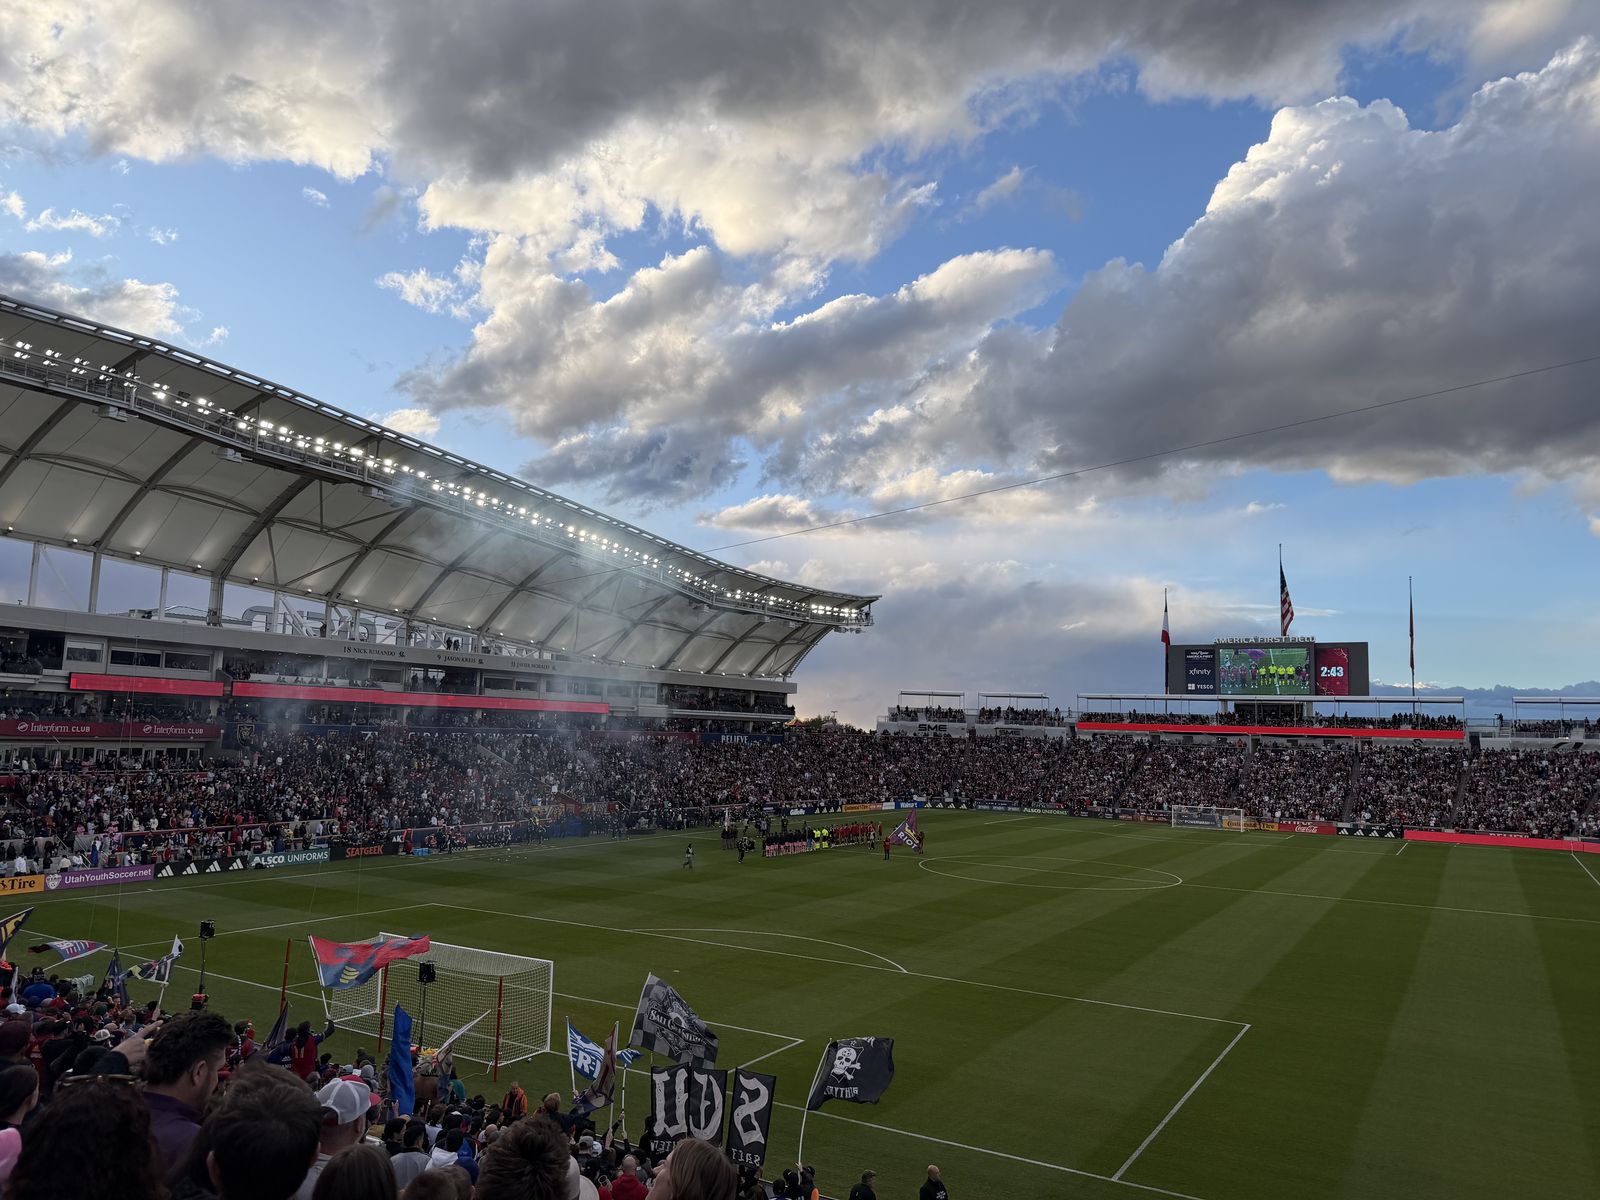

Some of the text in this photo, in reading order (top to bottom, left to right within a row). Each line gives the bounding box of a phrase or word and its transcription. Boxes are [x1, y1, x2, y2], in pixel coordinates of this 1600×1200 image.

[1214, 635, 1316, 644] AMERICA FIRST FIELD
[1189, 668, 1211, 676] xfinity
[1320, 666, 1344, 677] 2:43
[30, 722, 69, 733] Interform
[153, 724, 204, 735] Interform CLUB
[918, 724, 947, 732] SME
[898, 831, 918, 850] RIOT
[287, 851, 328, 863] UNIFORMS
[345, 844, 384, 859] SEATGEEK
[64, 868, 152, 884] UtahYouthSoccer.net
[10, 878, 36, 890] Tire
